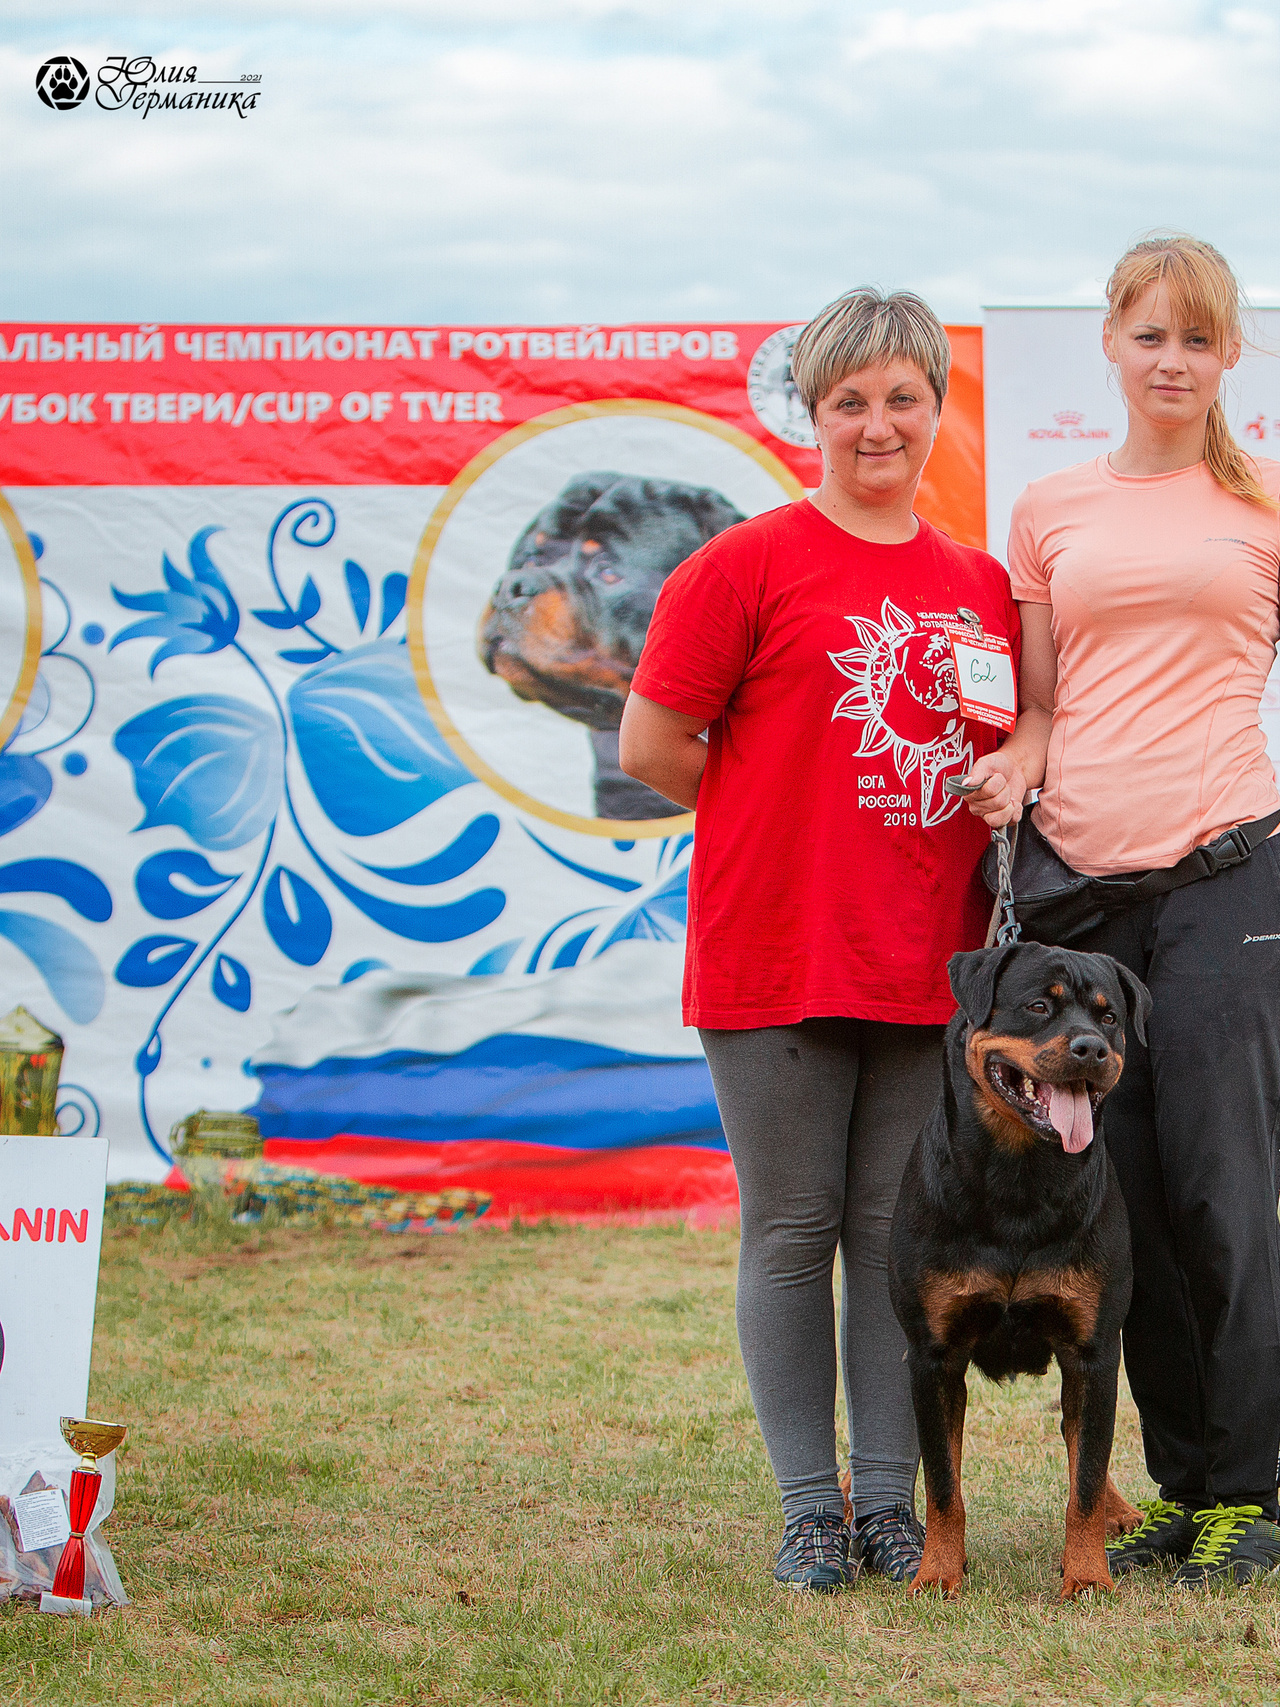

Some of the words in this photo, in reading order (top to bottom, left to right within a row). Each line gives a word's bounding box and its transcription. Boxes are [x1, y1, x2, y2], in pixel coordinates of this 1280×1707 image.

[174, 330, 440, 362] ЧЕМПИОНАТ
[448, 325, 739, 361] РОТВЕЙЛЕРОВ
[103, 391, 332, 427] ТВЕРИ/CUP
[339, 391, 393, 423] OF
[401, 391, 504, 423] TVER
[858, 775, 886, 789] ЮГА
[858, 794, 911, 809] РОССИИ
[883, 812, 917, 826] 2019
